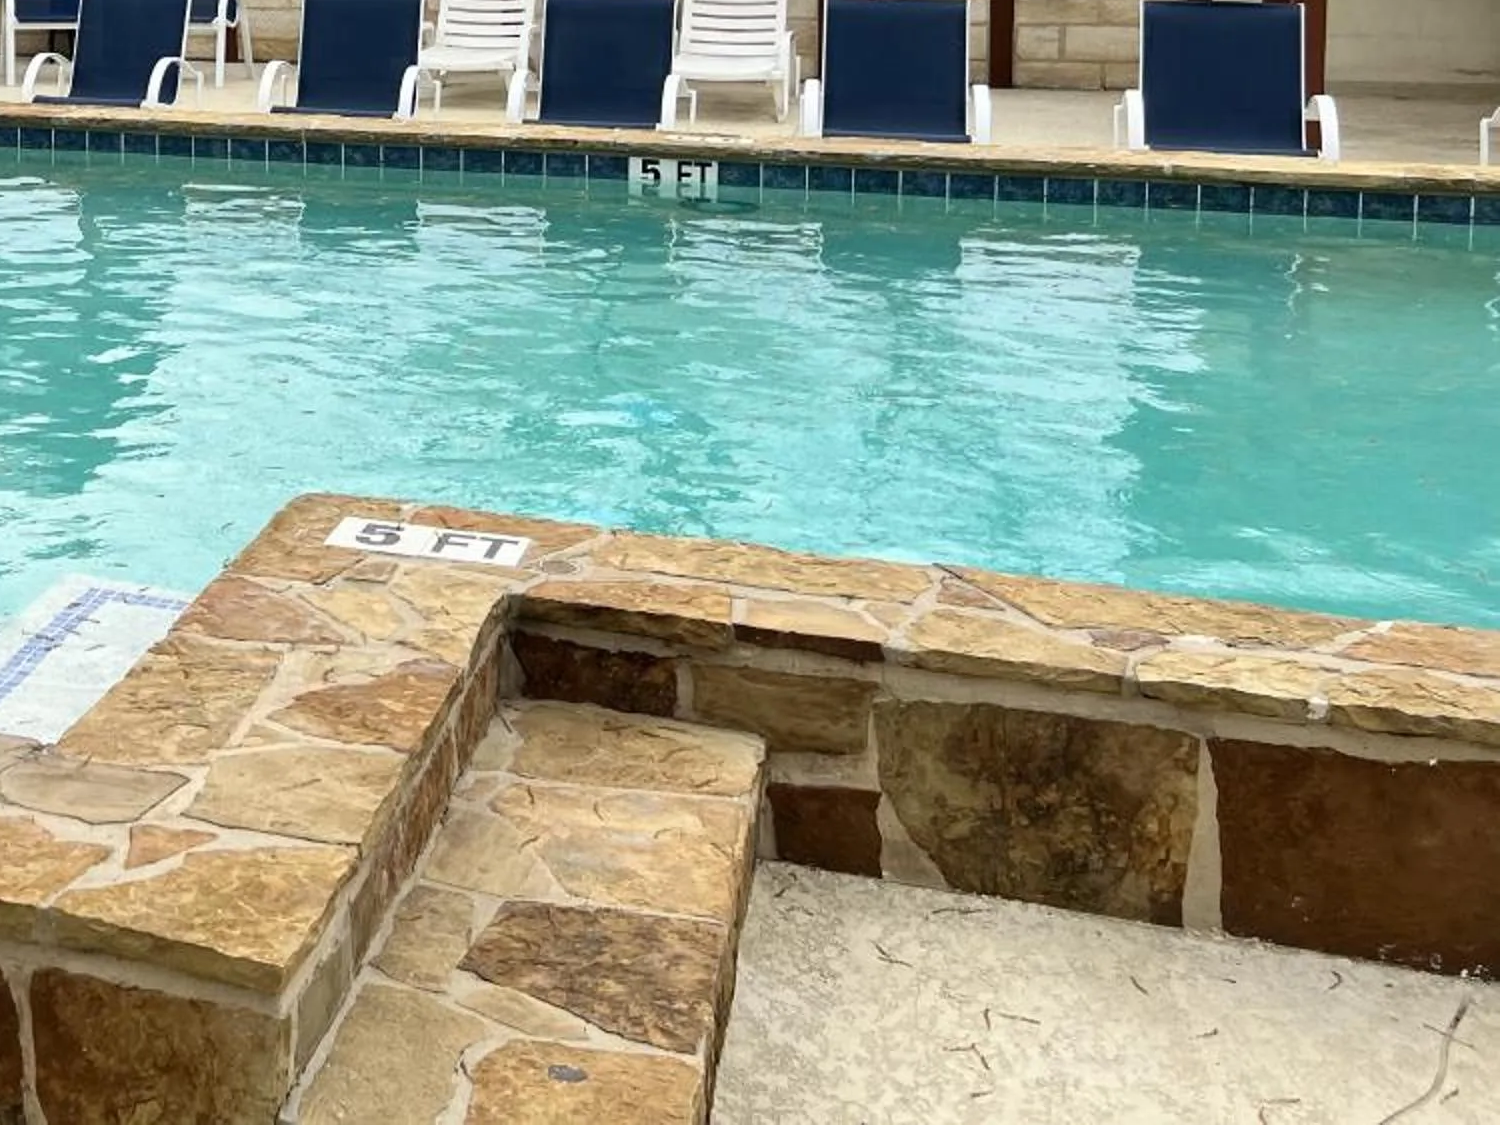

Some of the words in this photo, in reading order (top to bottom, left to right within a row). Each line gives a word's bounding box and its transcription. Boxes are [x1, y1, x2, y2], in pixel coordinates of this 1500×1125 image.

[641, 159, 660, 180] 5
[677, 161, 712, 182] FT
[355, 522, 404, 546] 5
[431, 532, 519, 559] FT
